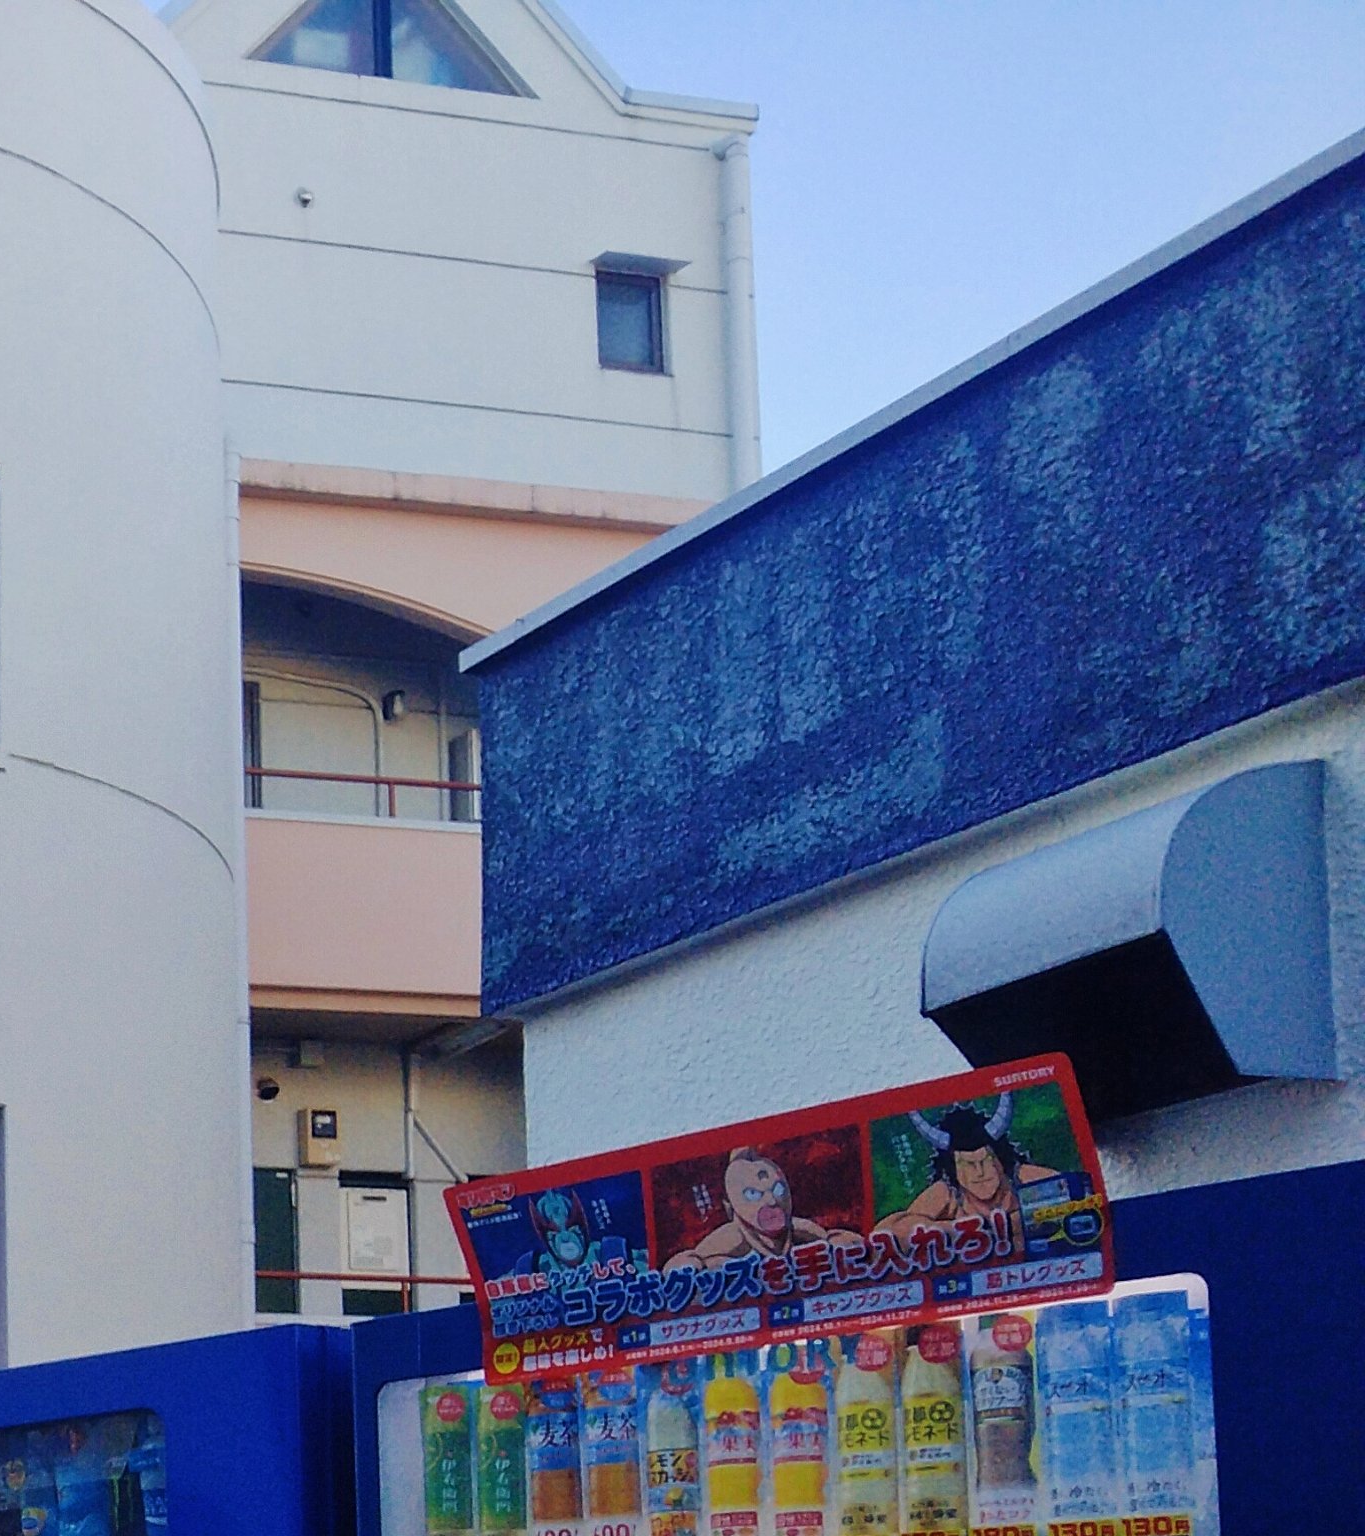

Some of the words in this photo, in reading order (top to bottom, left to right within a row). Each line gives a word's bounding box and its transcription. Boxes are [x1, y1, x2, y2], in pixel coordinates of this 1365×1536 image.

[662, 1311, 745, 1338] サウナグッズ
[599, 1412, 637, 1441] 麦茶
[1121, 1516, 1191, 1536] 130円
